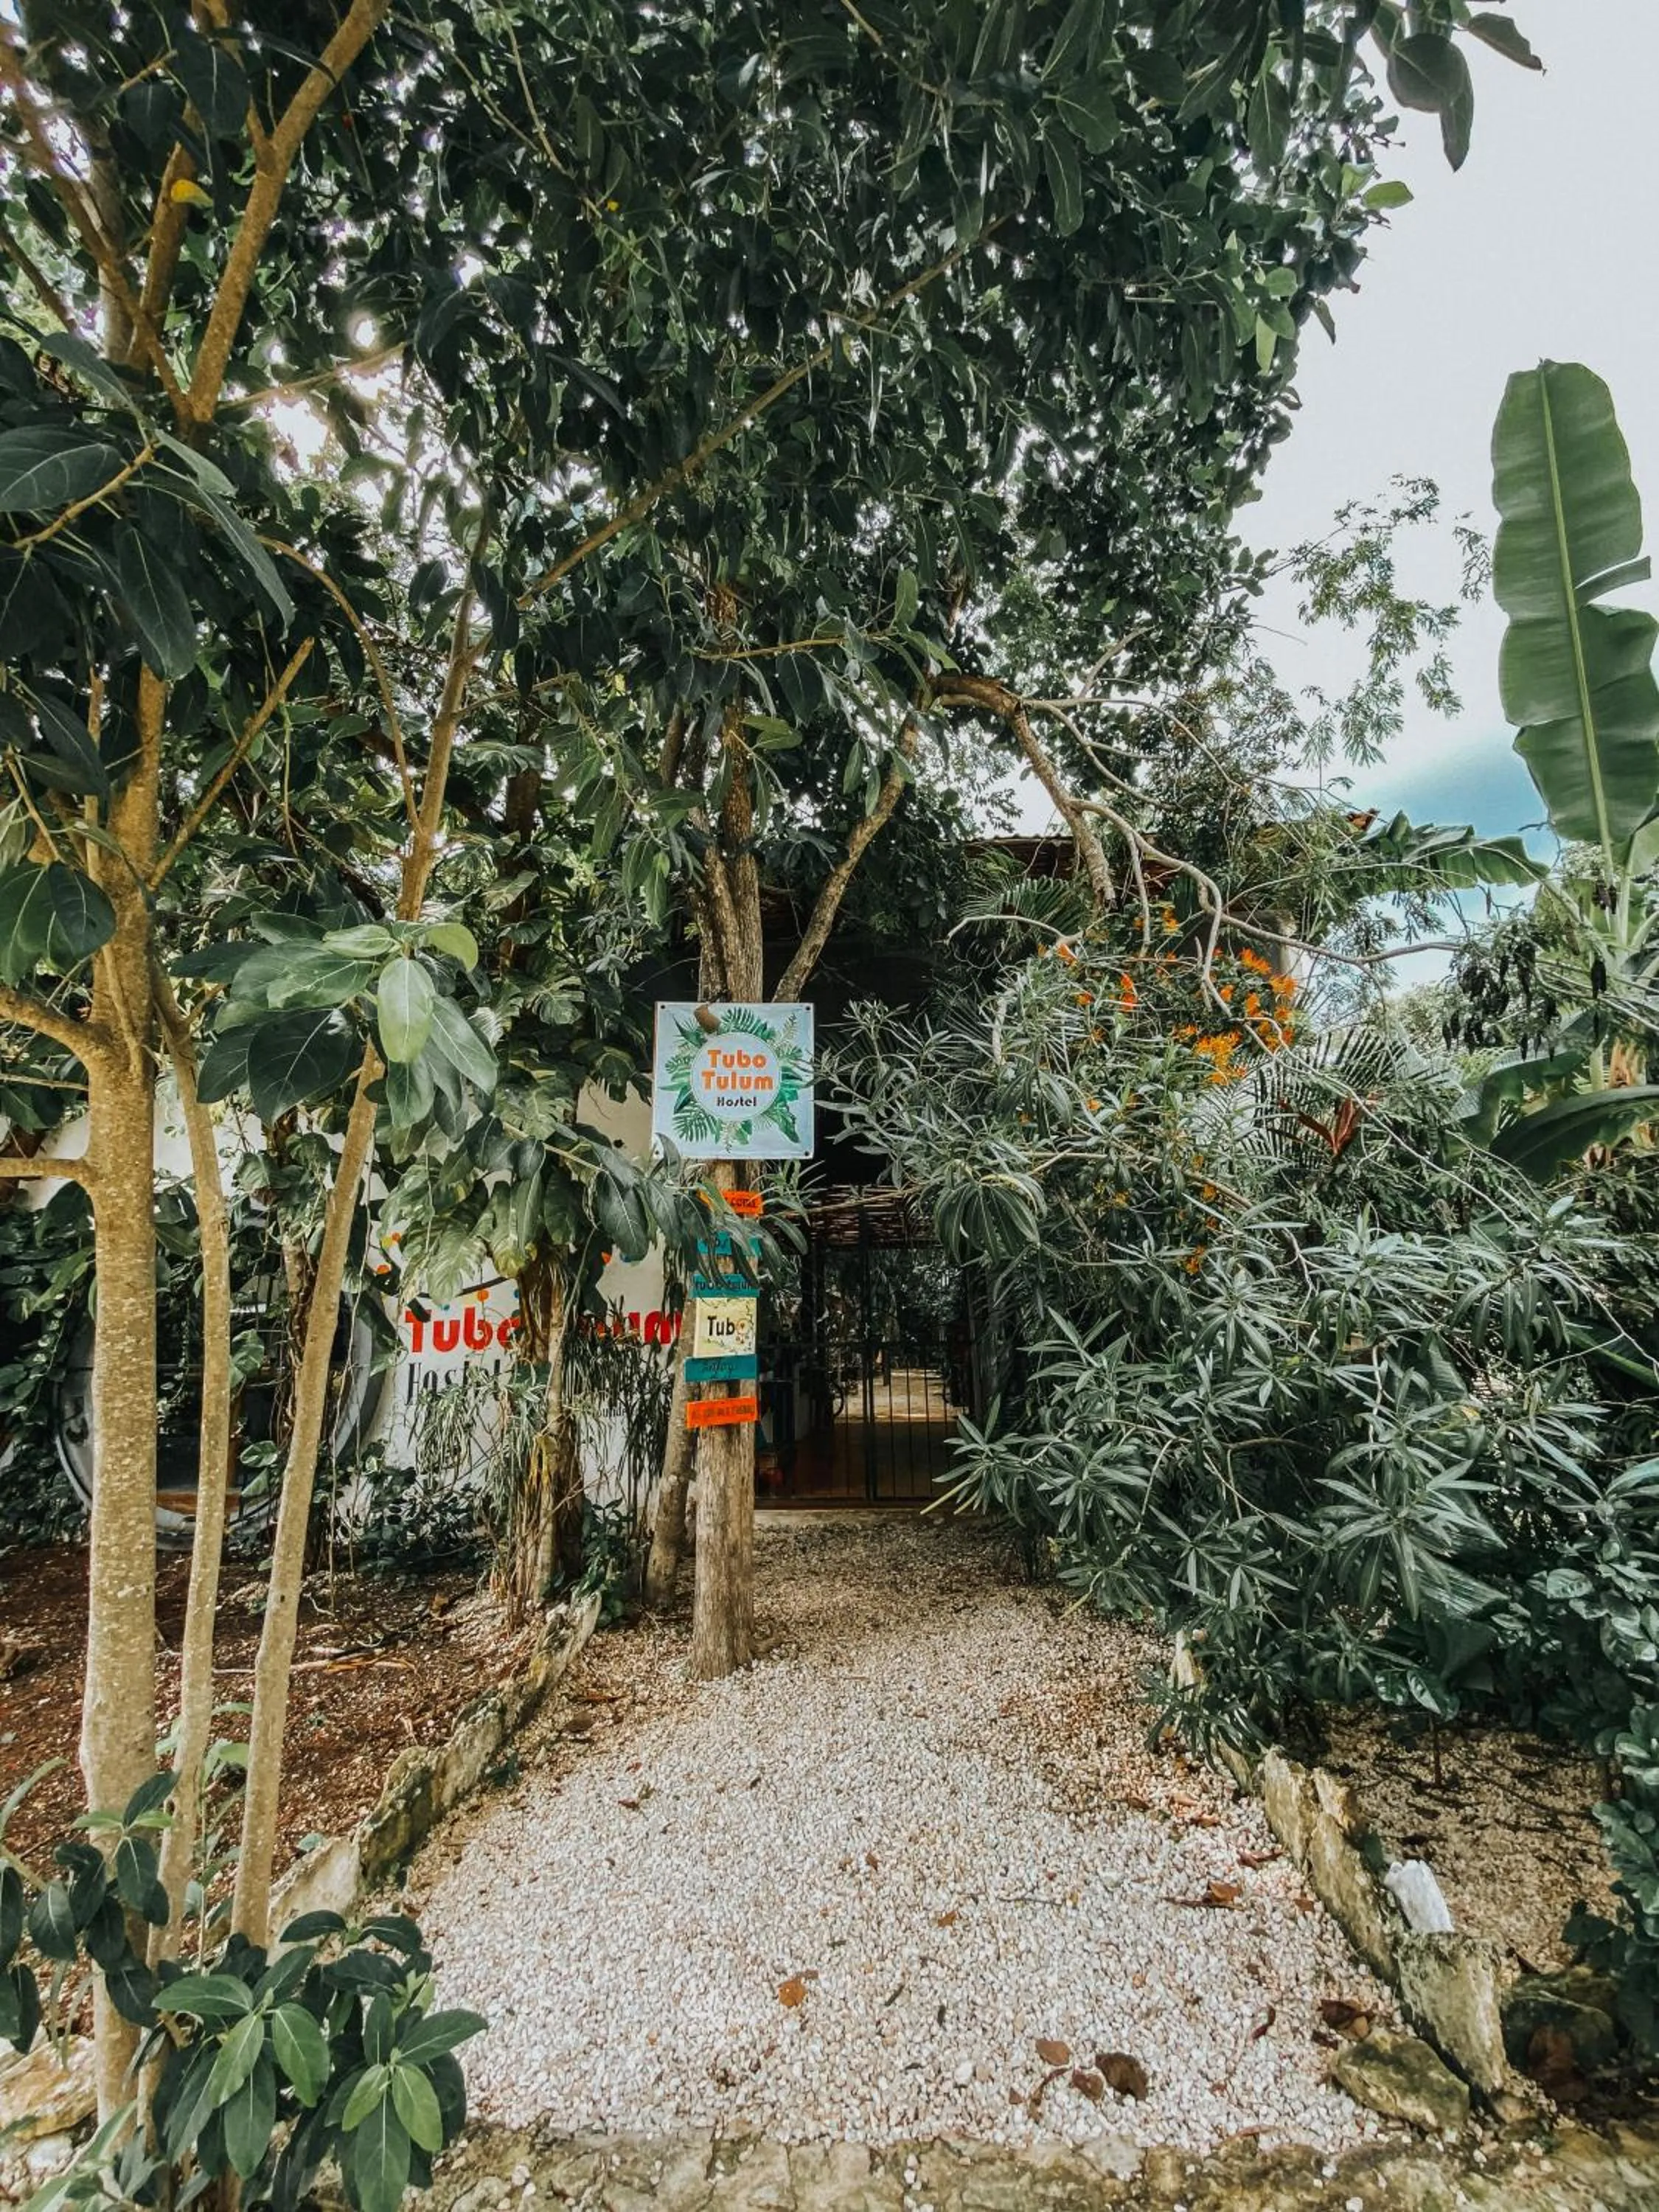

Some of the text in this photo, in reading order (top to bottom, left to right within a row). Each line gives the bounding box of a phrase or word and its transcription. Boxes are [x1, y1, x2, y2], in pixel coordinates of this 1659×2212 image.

[707, 1049, 768, 1068] Tubo
[701, 1071, 773, 1091] Tulum
[717, 1096, 757, 1107] Hostel
